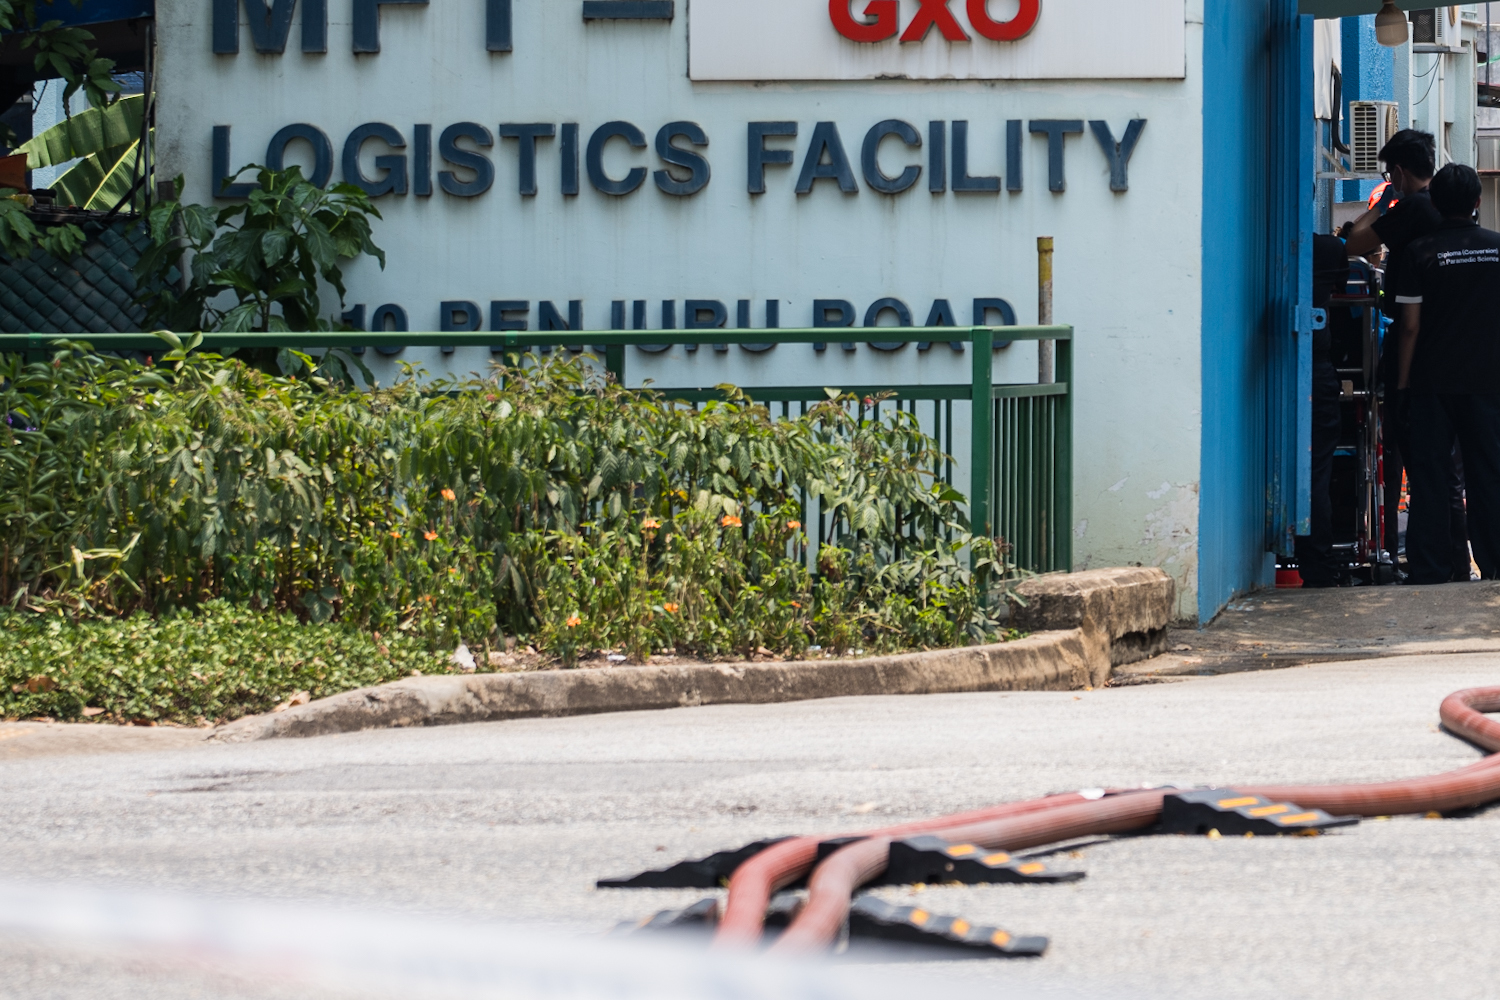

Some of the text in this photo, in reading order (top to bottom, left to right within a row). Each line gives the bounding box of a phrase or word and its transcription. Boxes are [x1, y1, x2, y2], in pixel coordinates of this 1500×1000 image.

[212, 118, 1147, 198] LOGISTICS FACILITY
[341, 302, 409, 355] 10
[813, 297, 1017, 351] ROAD
